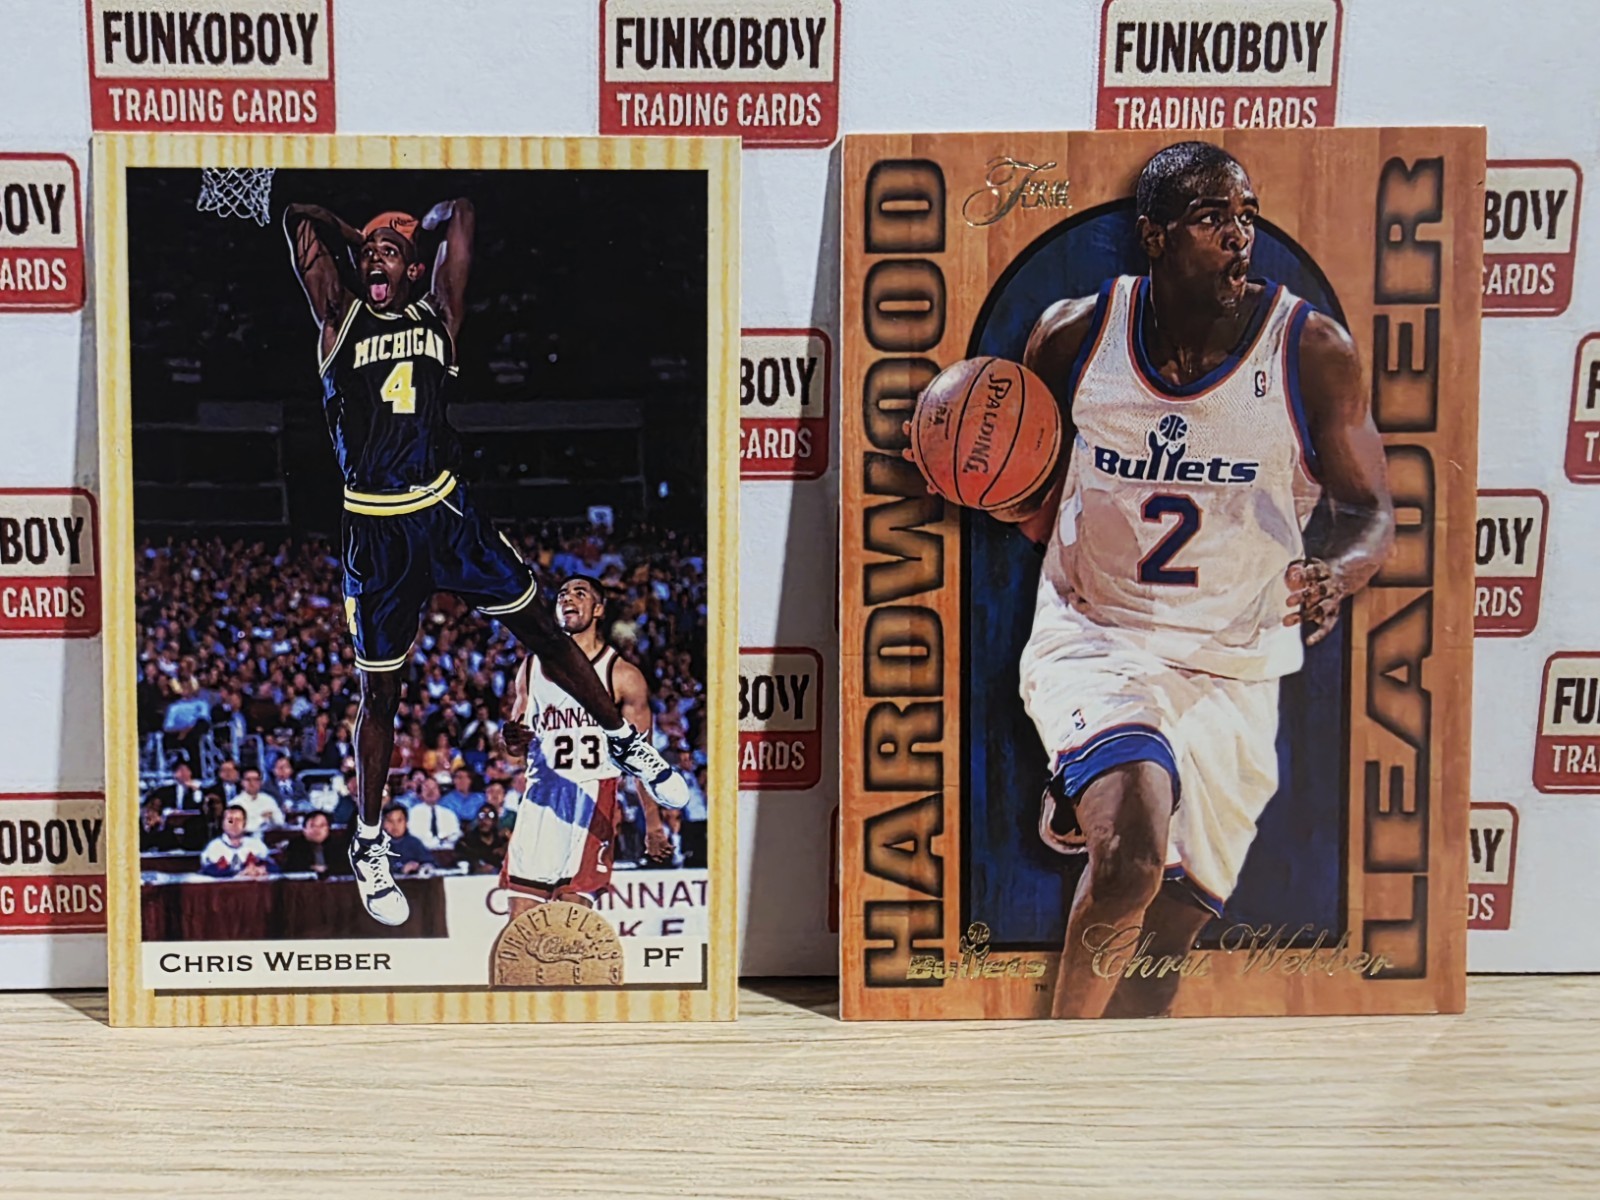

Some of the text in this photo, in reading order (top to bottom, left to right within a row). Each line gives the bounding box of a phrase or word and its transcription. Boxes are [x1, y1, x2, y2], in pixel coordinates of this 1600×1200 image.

[108, 88, 318, 124] TRADING CARDS
[616, 92, 822, 127] TRADING CARDS
[1114, 97, 1318, 130] TRADING CARDS
[380, 361, 417, 414] 4
[962, 371, 1013, 475] SPALDING
[1094, 431, 1259, 484] Bullets
[1137, 491, 1203, 587] 2
[862, 158, 947, 988] HARDWOOD
[1362, 155, 1444, 980] LEADER
[2, 586, 86, 618] CARDS
[554, 734, 600, 770] 23
[23, 884, 104, 915] CARDS
[159, 951, 392, 973] CHRIS WEBBER
[643, 947, 684, 968] PF
[1220, 922, 1395, 978] Webber
